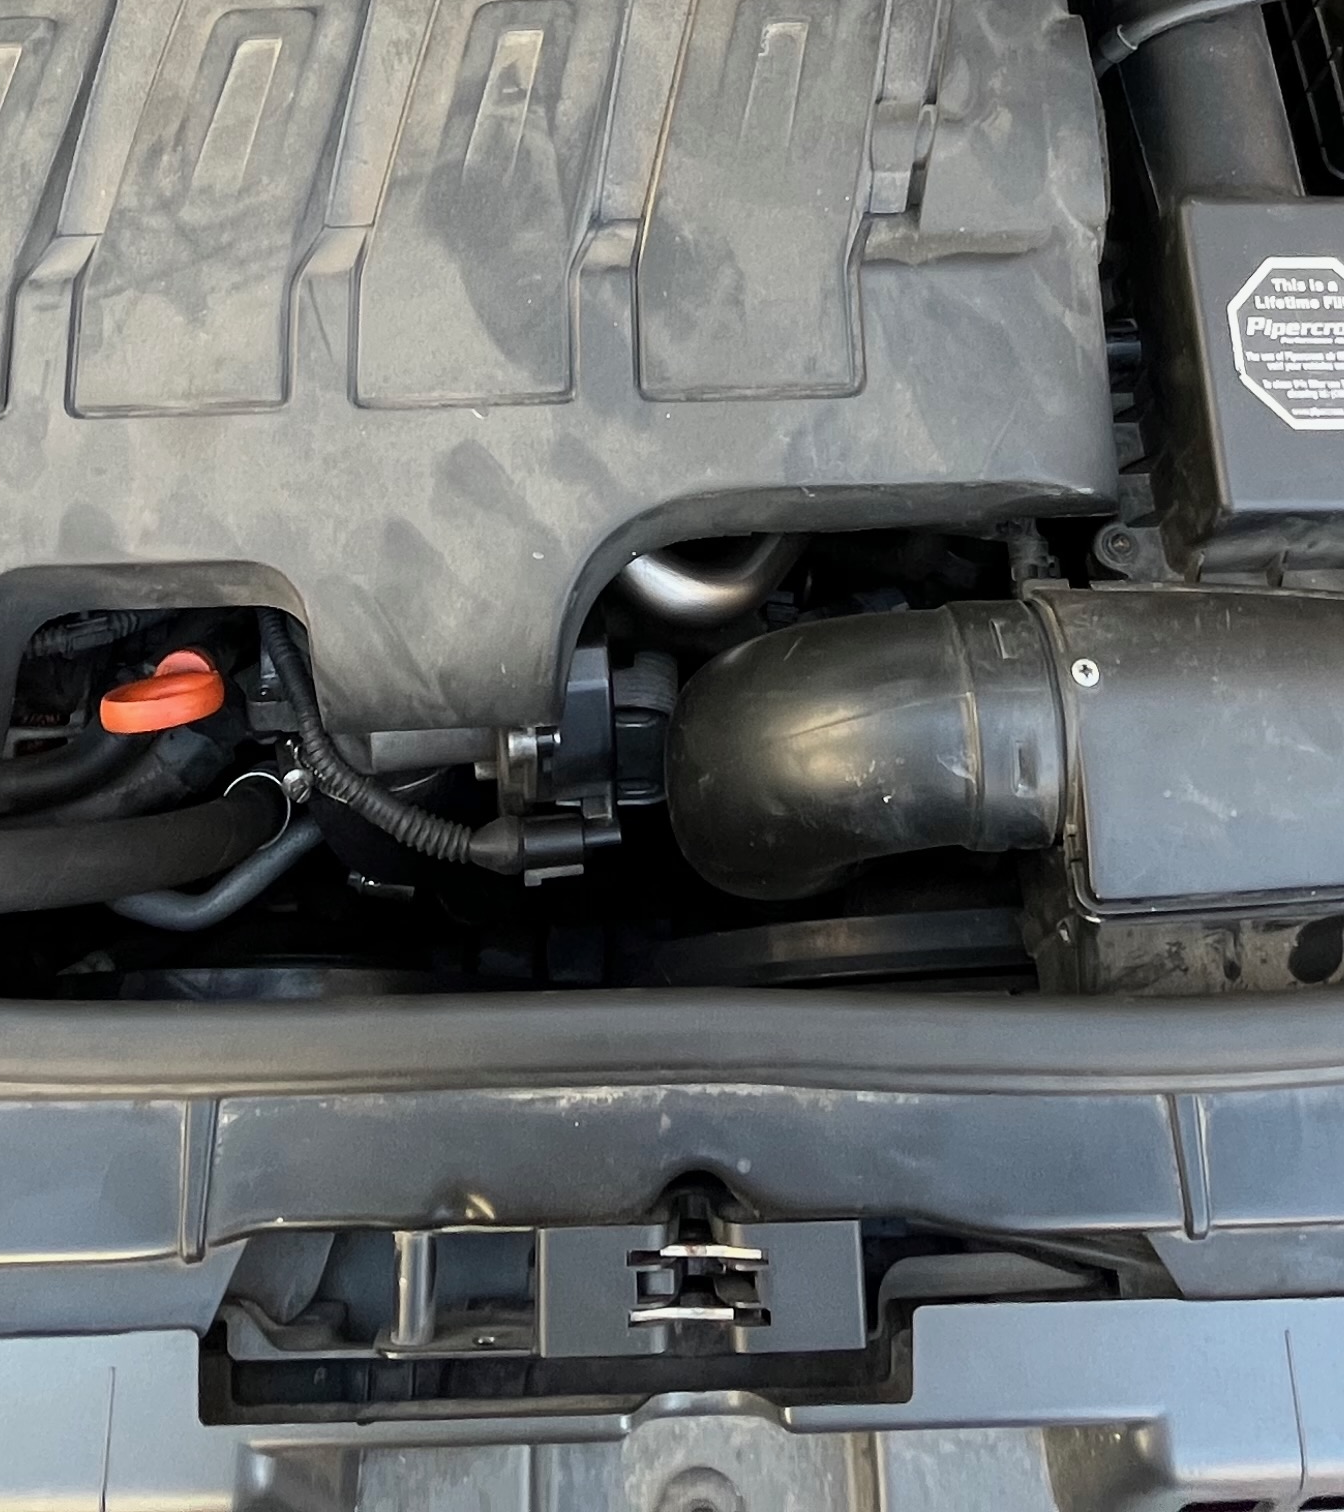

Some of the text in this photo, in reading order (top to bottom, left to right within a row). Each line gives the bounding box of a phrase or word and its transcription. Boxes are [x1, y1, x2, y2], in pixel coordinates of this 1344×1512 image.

[1270, 278, 1306, 292] This
[1327, 280, 1339, 292] a
[1254, 295, 1320, 310] Lifetime
